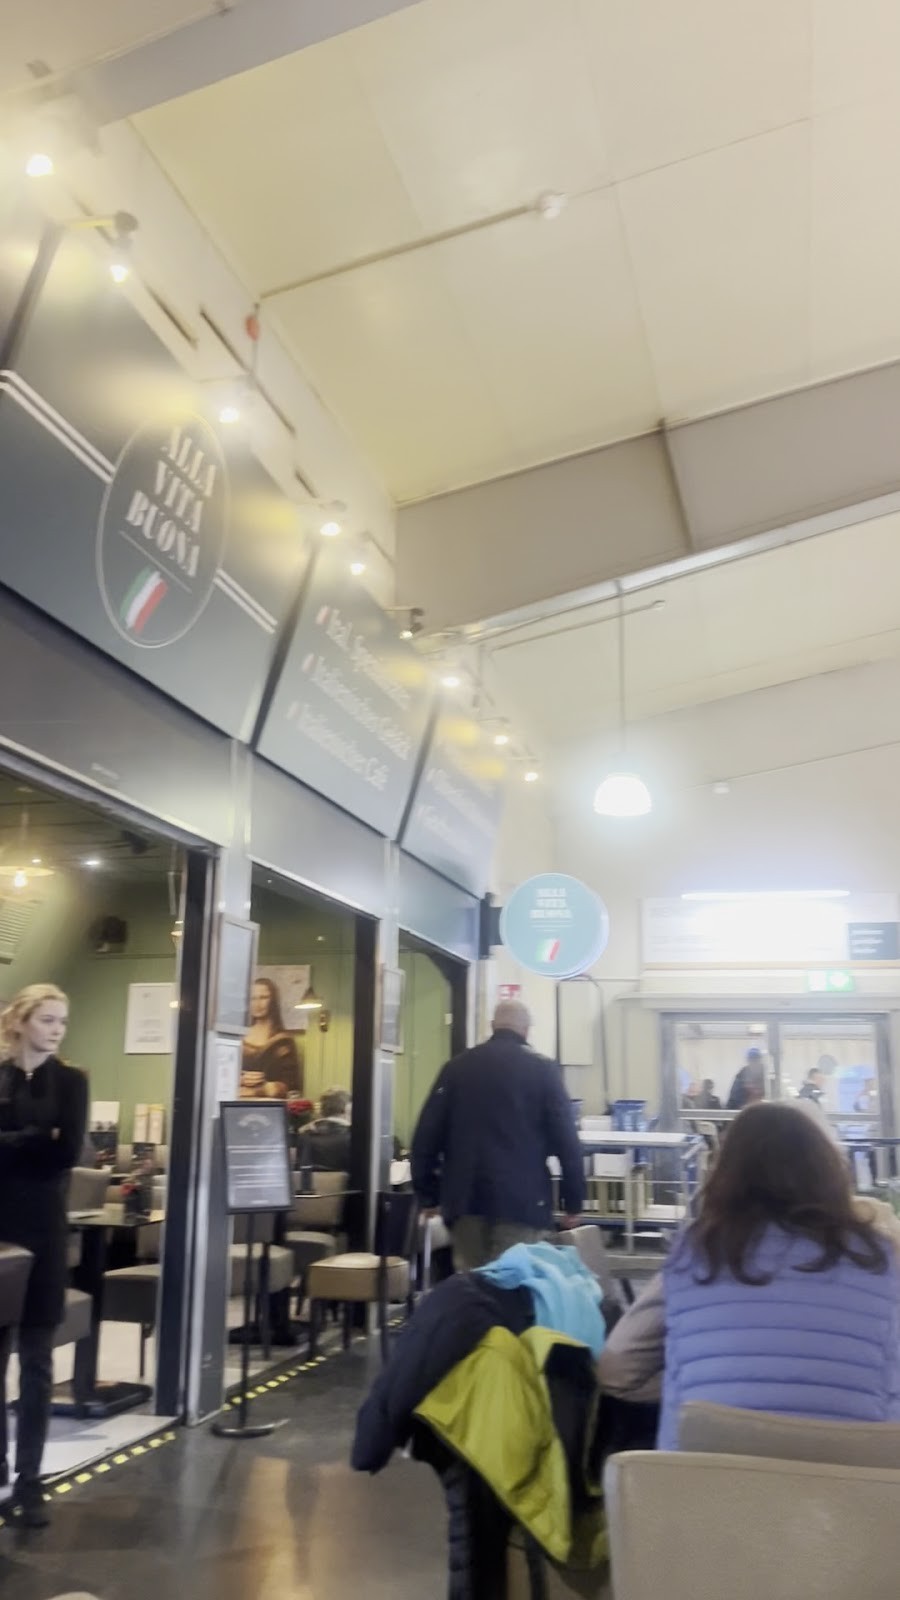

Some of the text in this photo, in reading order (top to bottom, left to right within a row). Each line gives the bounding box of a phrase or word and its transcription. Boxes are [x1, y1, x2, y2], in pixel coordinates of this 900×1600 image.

[154, 460, 204, 533] VITA
[161, 425, 217, 498] ALLA
[125, 490, 201, 577] BUONA
